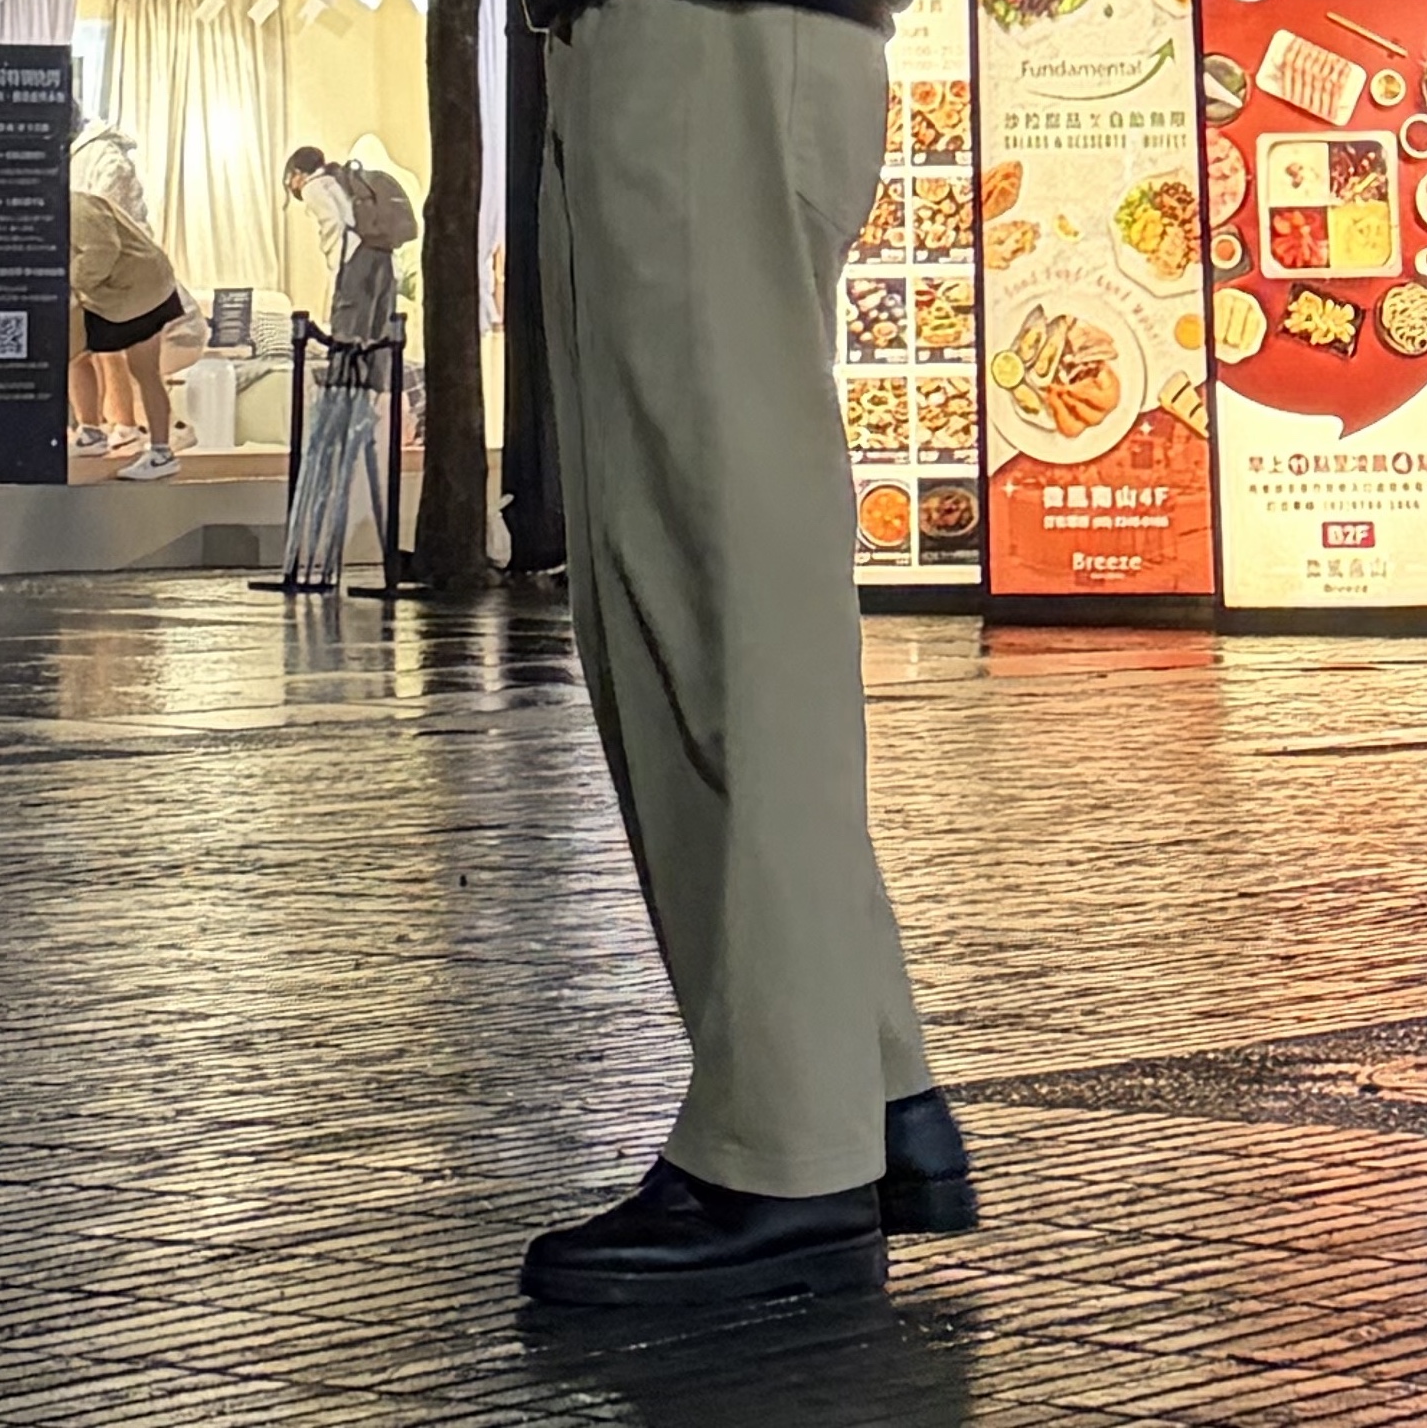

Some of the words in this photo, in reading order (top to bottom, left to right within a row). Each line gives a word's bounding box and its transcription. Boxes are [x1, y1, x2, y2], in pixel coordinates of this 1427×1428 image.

[1021, 59, 1143, 78] Fundamental
[1326, 525, 1370, 545] B2F
[1073, 552, 1143, 571] Breeze
